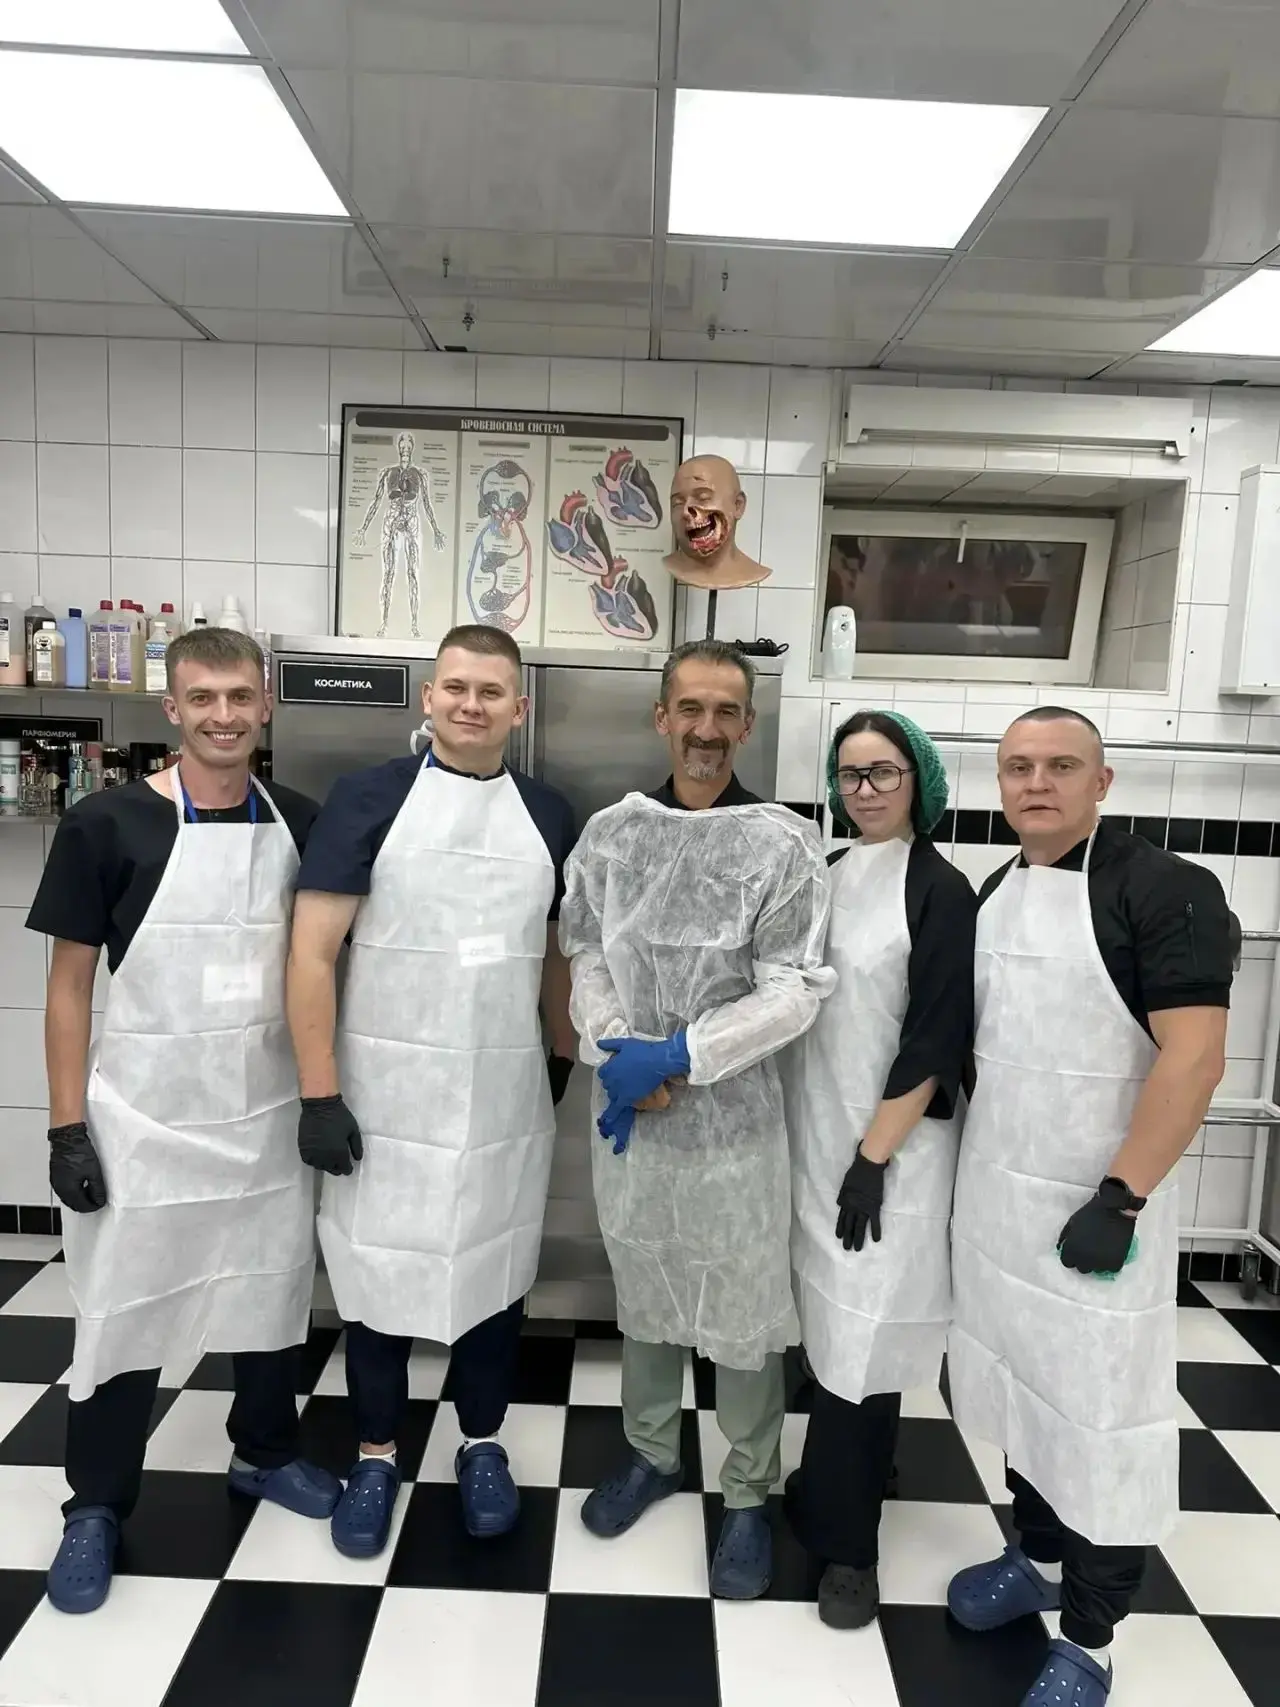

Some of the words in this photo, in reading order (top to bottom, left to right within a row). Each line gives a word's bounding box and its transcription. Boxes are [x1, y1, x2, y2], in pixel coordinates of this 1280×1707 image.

[460, 419, 524, 432] КРОВЕНОСНАЯ
[527, 422, 565, 434] СИСТЕМА
[314, 678, 373, 689] КОСМЕТИКА
[22, 729, 77, 738] ПАРФЮМЕРИЯ
